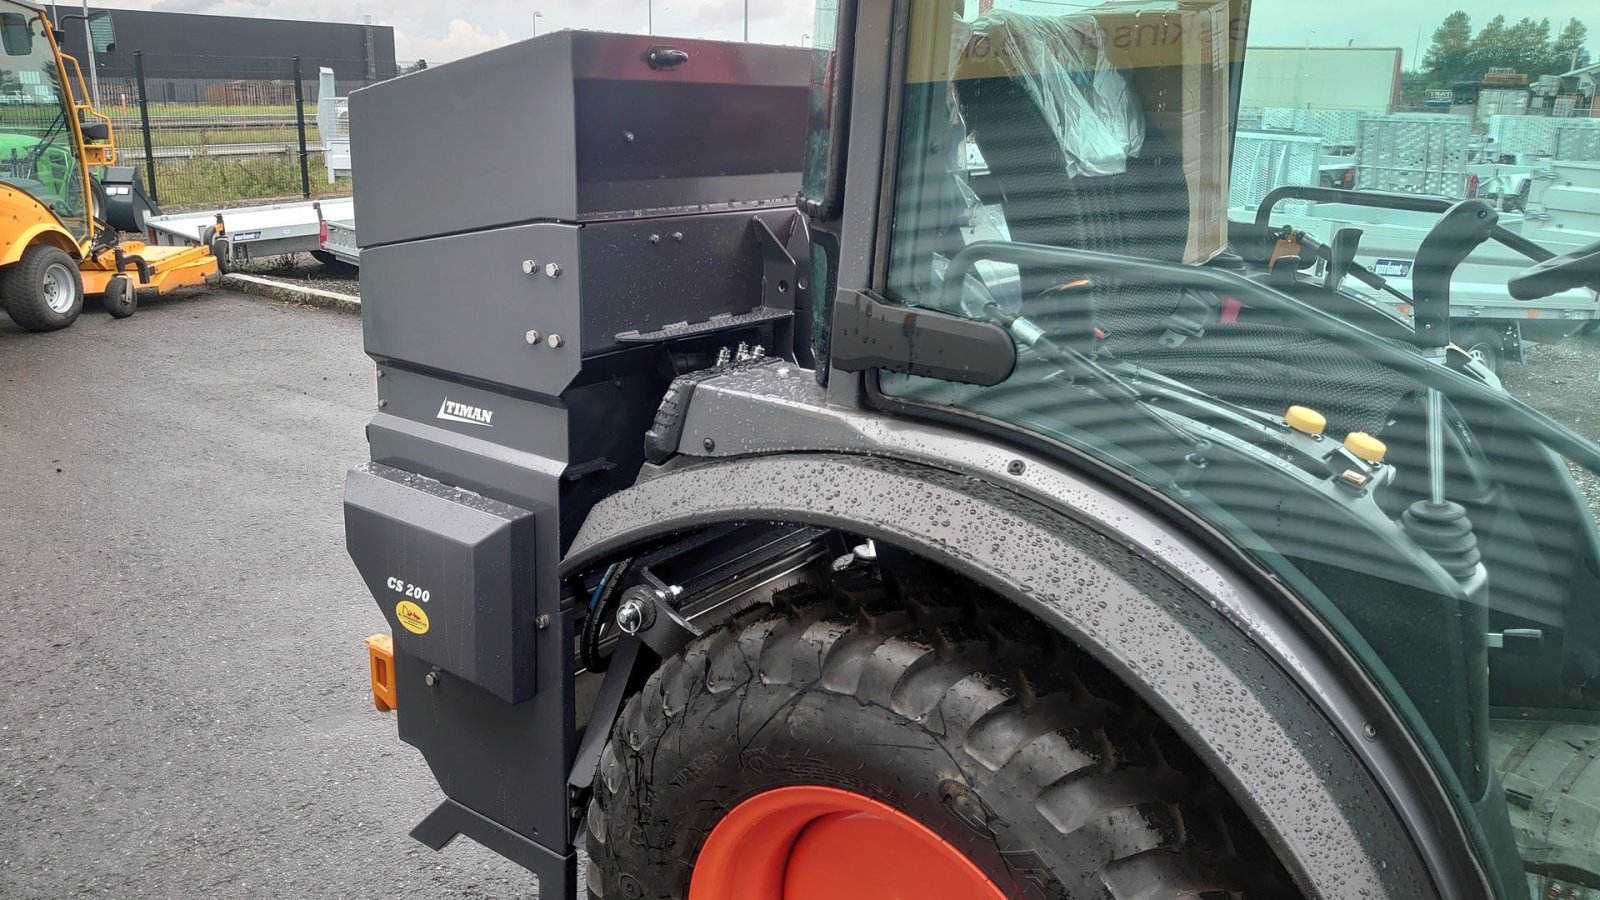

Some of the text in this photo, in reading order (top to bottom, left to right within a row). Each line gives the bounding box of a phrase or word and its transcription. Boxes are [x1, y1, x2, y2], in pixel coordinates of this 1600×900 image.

[446, 400, 493, 423] TIMAN
[387, 576, 430, 602] CS 200
